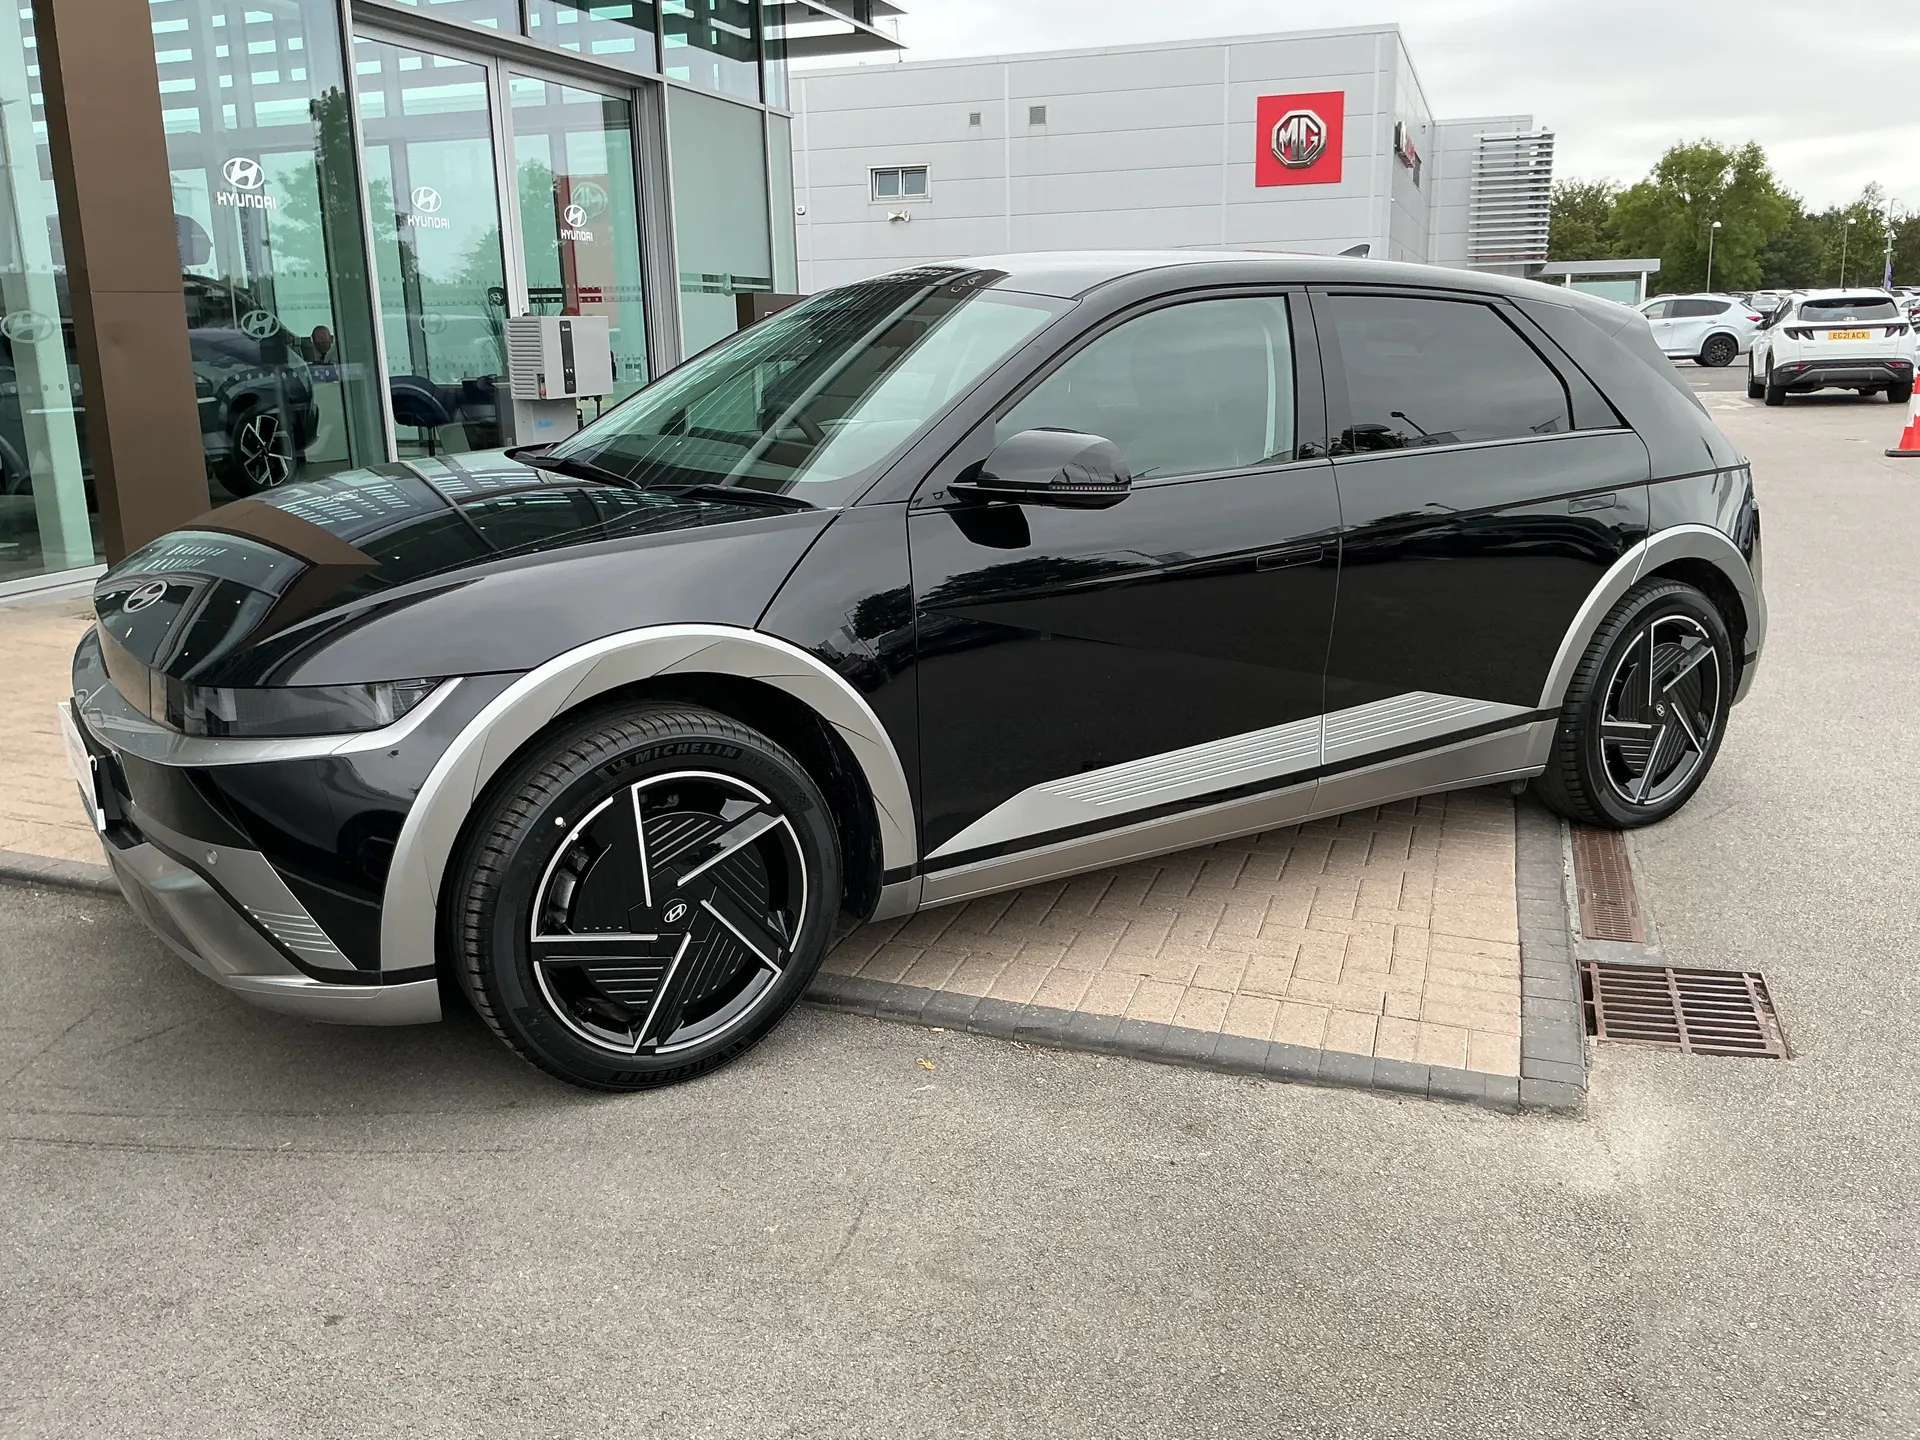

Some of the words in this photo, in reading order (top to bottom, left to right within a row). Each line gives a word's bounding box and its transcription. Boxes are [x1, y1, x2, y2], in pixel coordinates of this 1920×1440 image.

[1278, 116, 1321, 162] MG
[216, 191, 277, 209] HYUNDAI
[407, 214, 450, 229] HYUNDAI
[560, 229, 594, 241] HYUNDAI
[635, 743, 738, 763] MICHELIN
